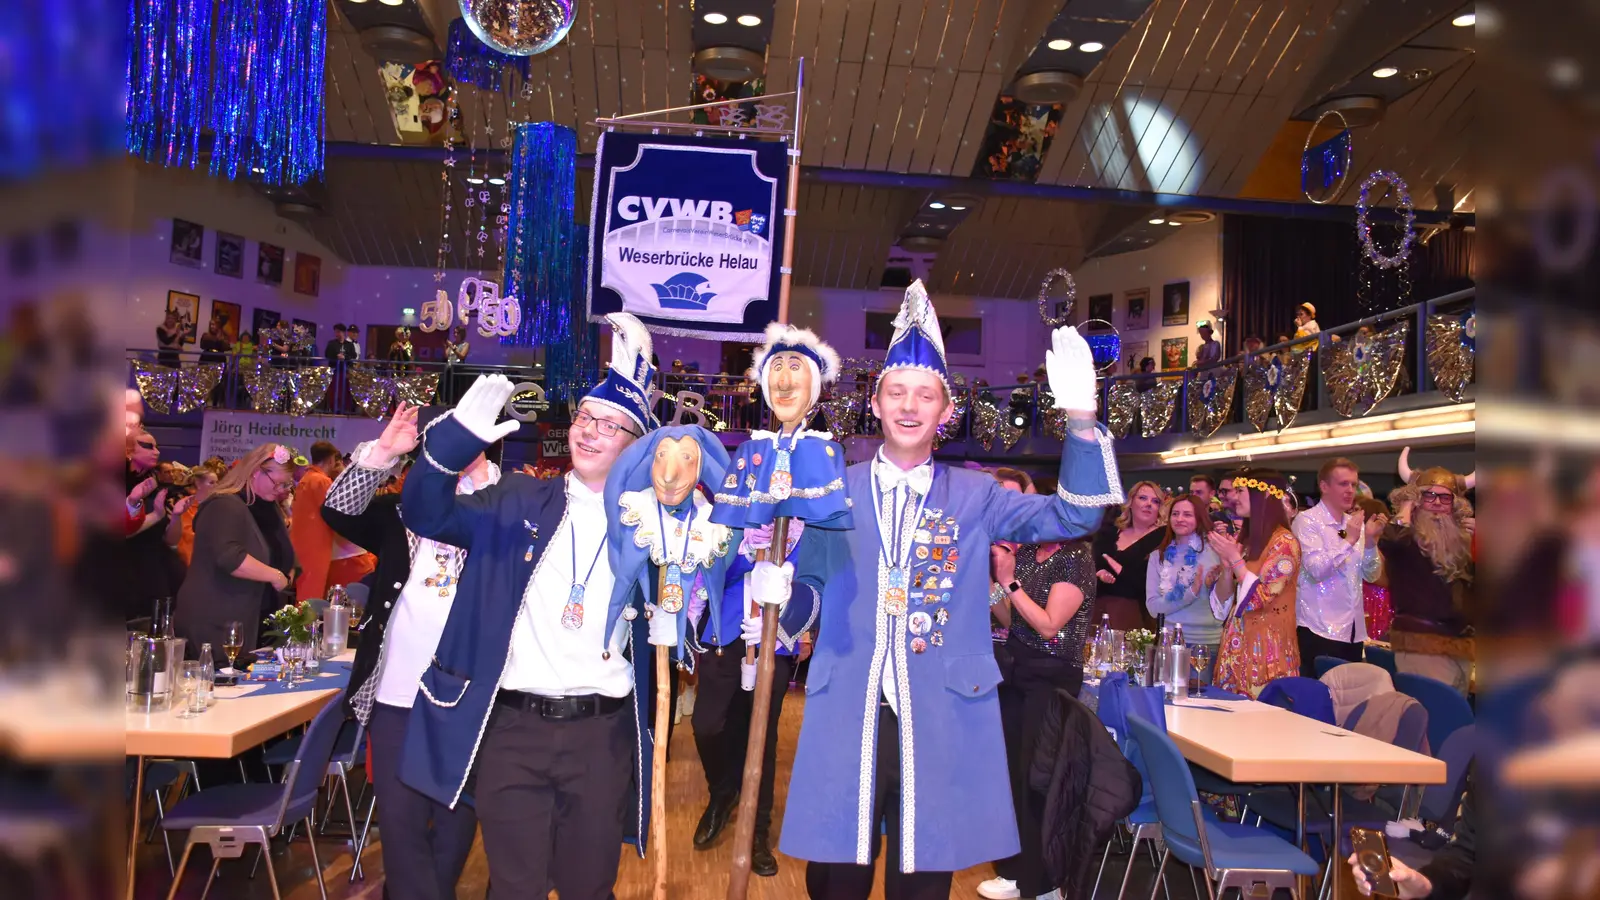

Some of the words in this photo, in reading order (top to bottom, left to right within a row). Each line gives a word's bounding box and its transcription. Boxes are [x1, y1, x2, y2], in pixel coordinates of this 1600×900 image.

[617, 195, 733, 224] CVWB
[619, 246, 714, 268] Weserbrücke
[719, 253, 758, 270] Helau
[210, 420, 243, 437] Jörg
[249, 422, 337, 439] Heidebrecht
